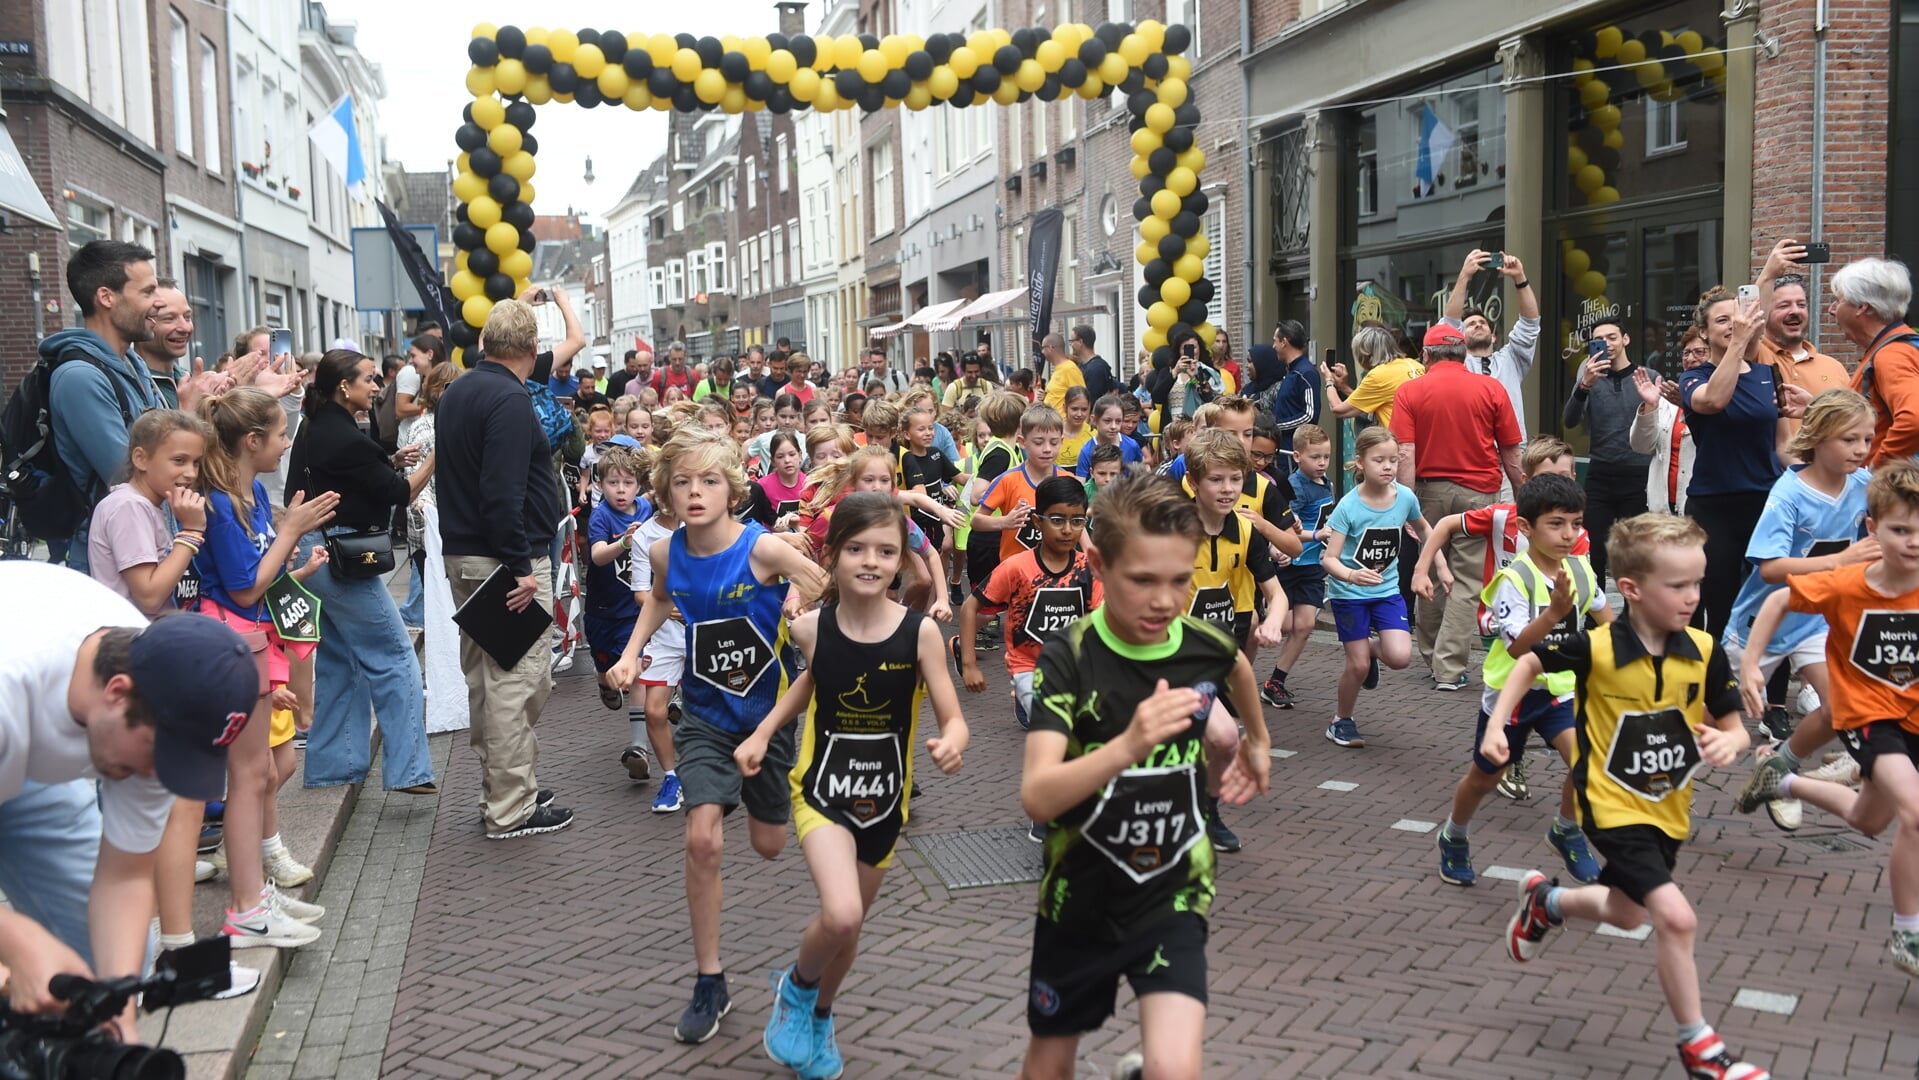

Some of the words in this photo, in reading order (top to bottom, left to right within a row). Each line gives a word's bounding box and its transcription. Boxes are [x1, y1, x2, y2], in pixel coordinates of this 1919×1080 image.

[1580, 297, 1602, 315] THE
[1577, 303, 1620, 329] I-BROW
[1561, 326, 1593, 359] FACT
[1362, 546, 1397, 560] M514
[177, 580, 199, 599] M654
[280, 597, 311, 630] 4603
[1045, 605, 1075, 614] Keyansh
[717, 640, 735, 649] Len
[1880, 630, 1918, 641] Morris
[708, 646, 756, 673] J297
[849, 758, 882, 771] Fenna
[1624, 744, 1687, 775] J302
[828, 772, 895, 798] M441
[1134, 800, 1174, 815] Leroy
[1106, 813, 1187, 847] J317
